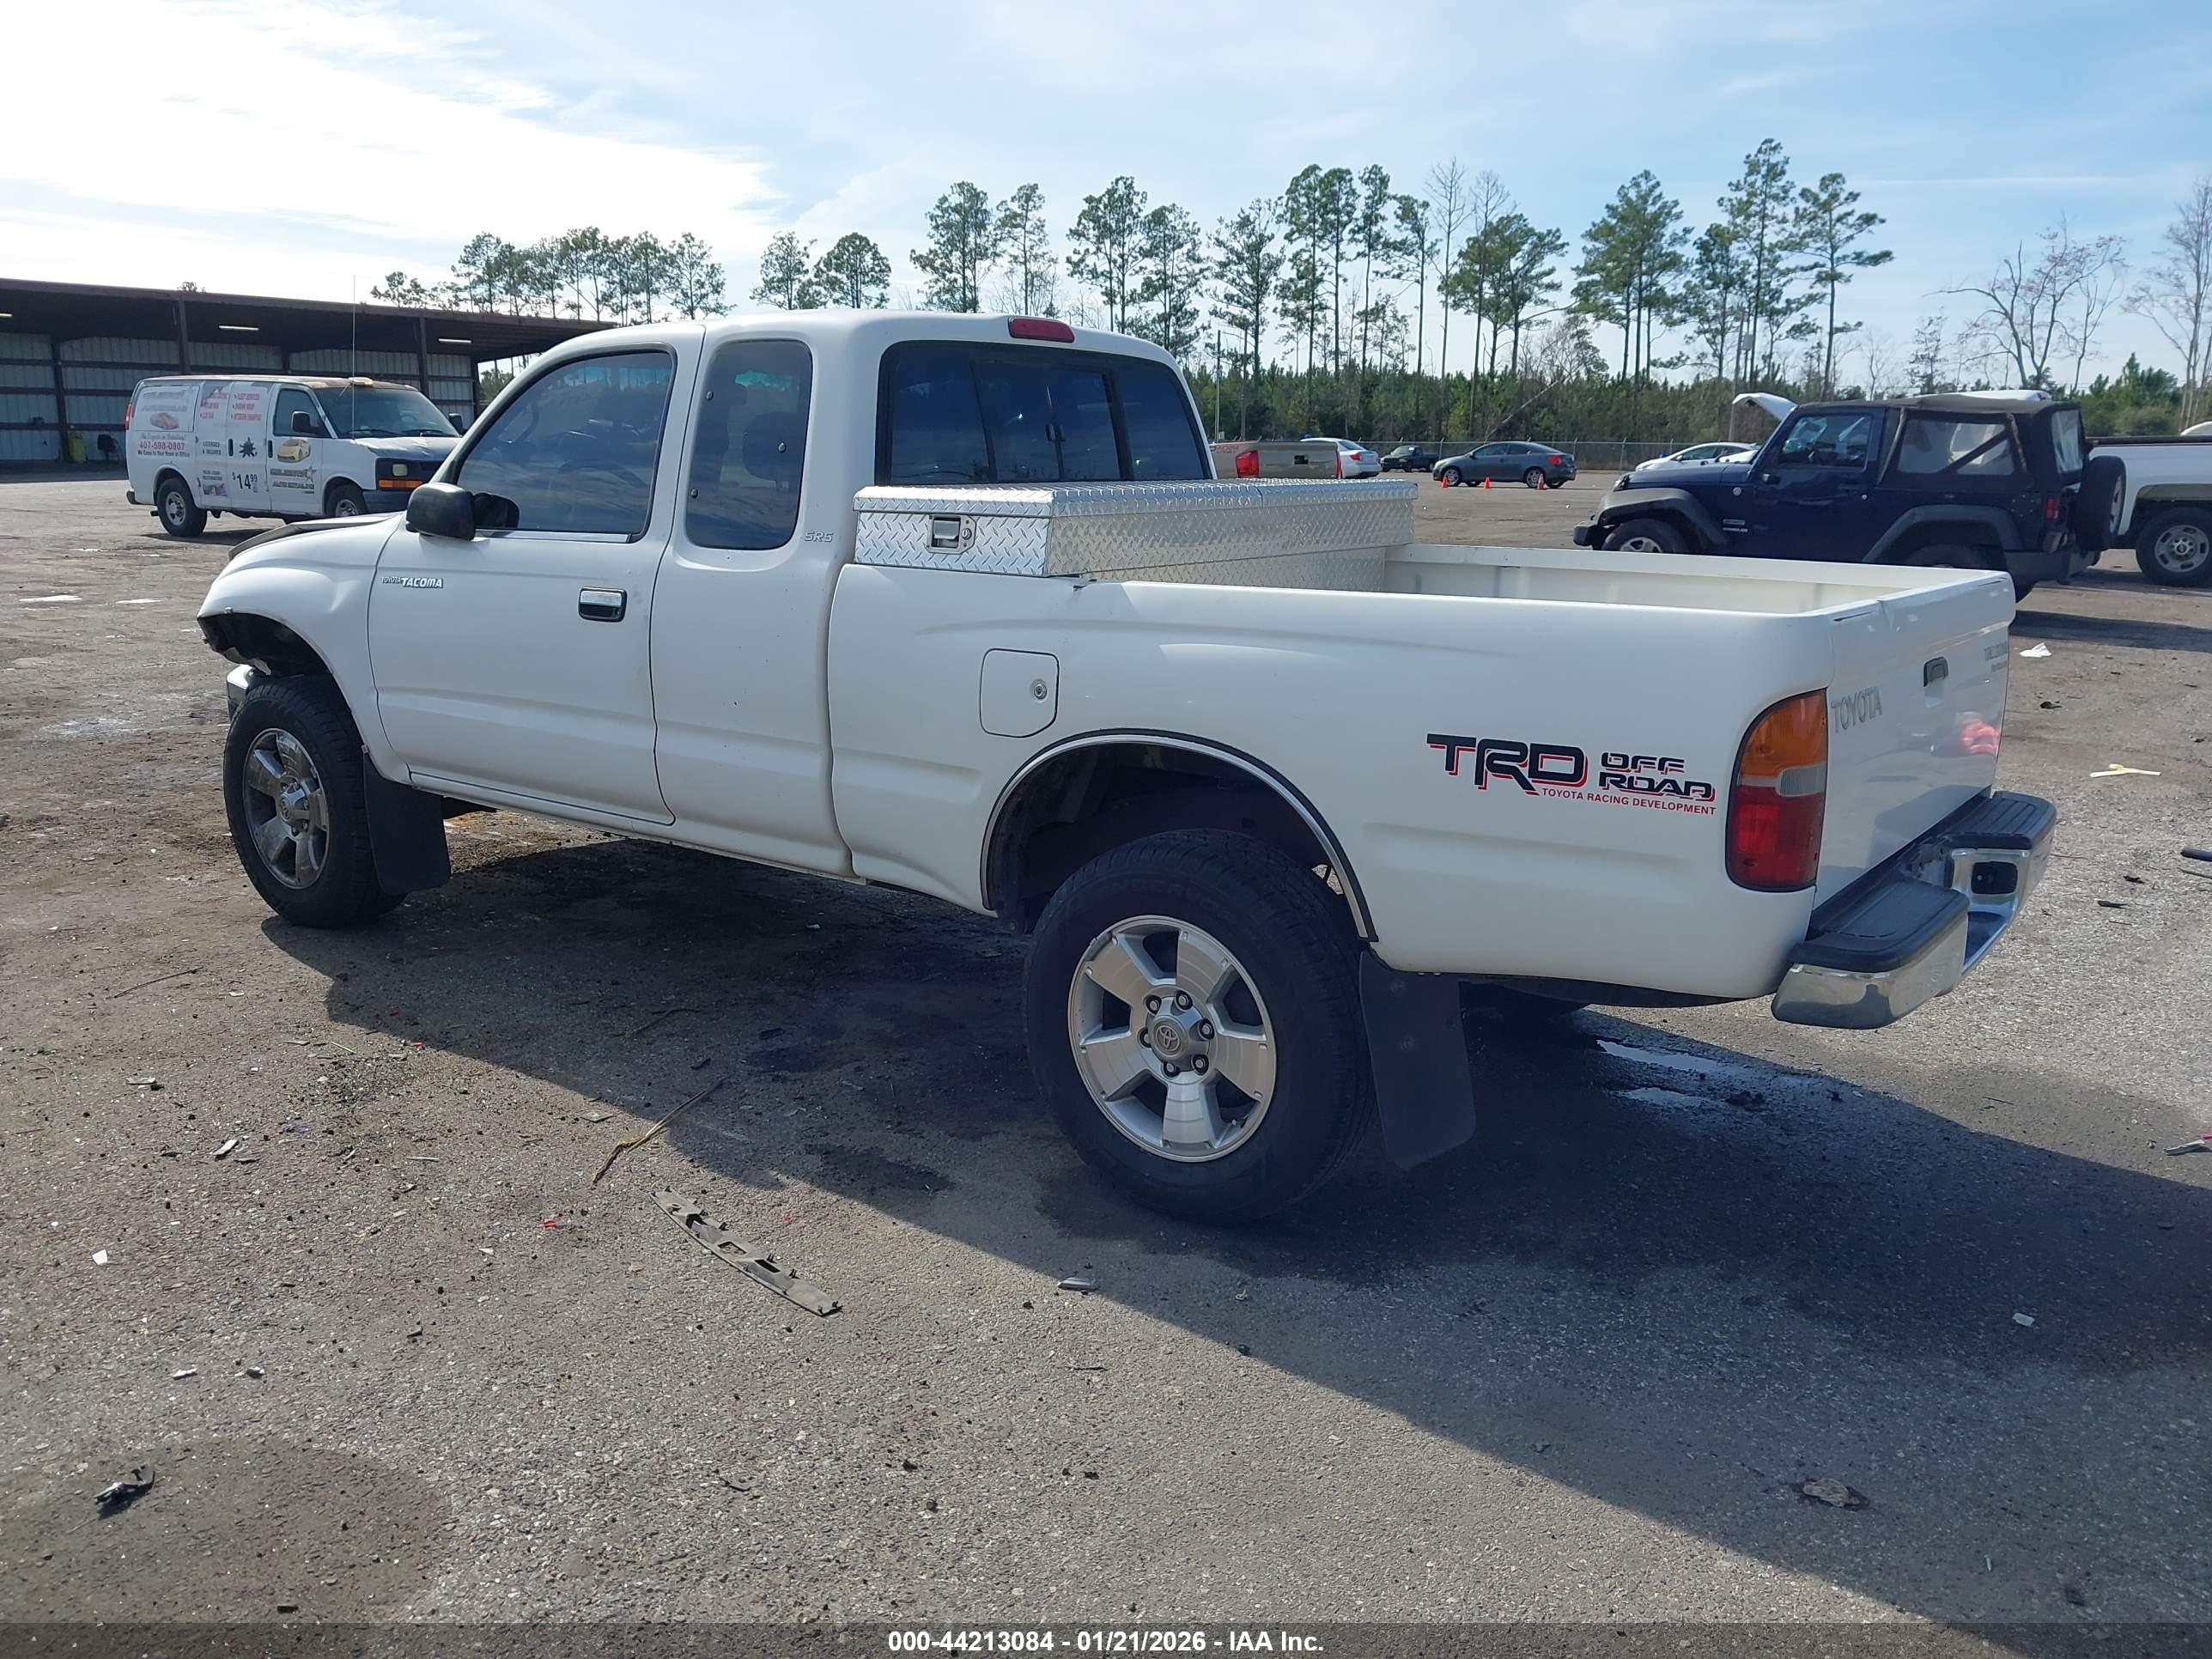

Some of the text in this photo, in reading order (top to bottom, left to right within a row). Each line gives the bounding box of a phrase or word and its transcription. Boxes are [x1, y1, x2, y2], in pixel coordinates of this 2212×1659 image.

[401, 577, 444, 588] TACOMA
[1831, 686, 1882, 733] TOYOTA
[1426, 733, 1589, 796] TRD
[1601, 751, 1686, 775] OFF
[1598, 770, 1716, 802] ROAD
[1542, 787, 1717, 816] TOYOTA RACING DEVELOPMENT
